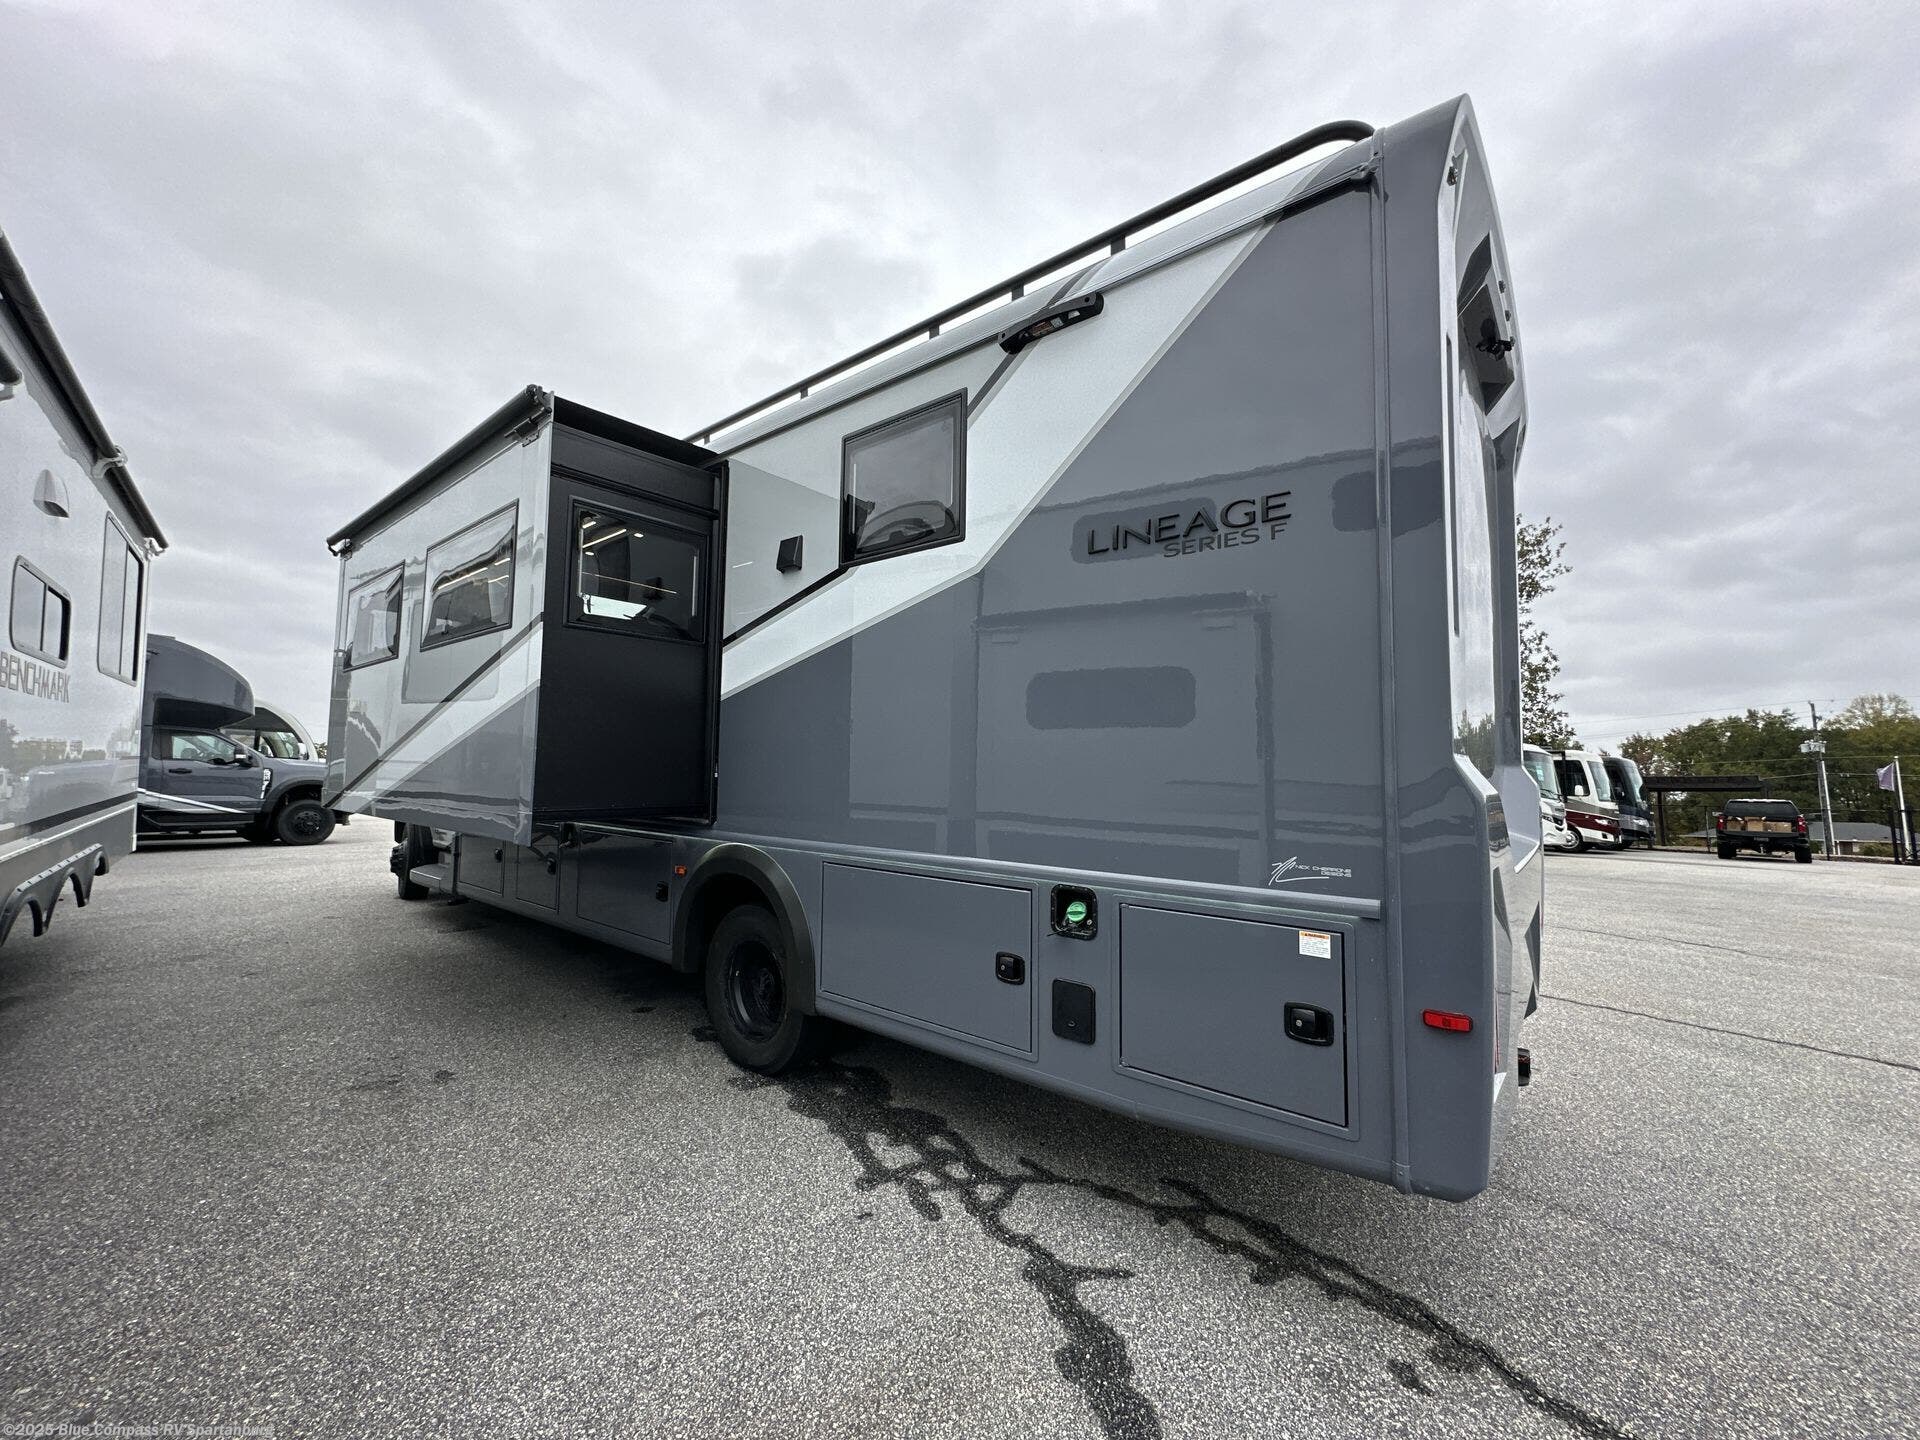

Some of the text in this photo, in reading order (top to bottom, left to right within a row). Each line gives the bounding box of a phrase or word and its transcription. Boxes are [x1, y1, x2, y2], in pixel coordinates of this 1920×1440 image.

[1087, 490, 1292, 555] LINEAGE
[1163, 522, 1288, 558] SERIES F
[0, 651, 70, 703] BENCHMARK
